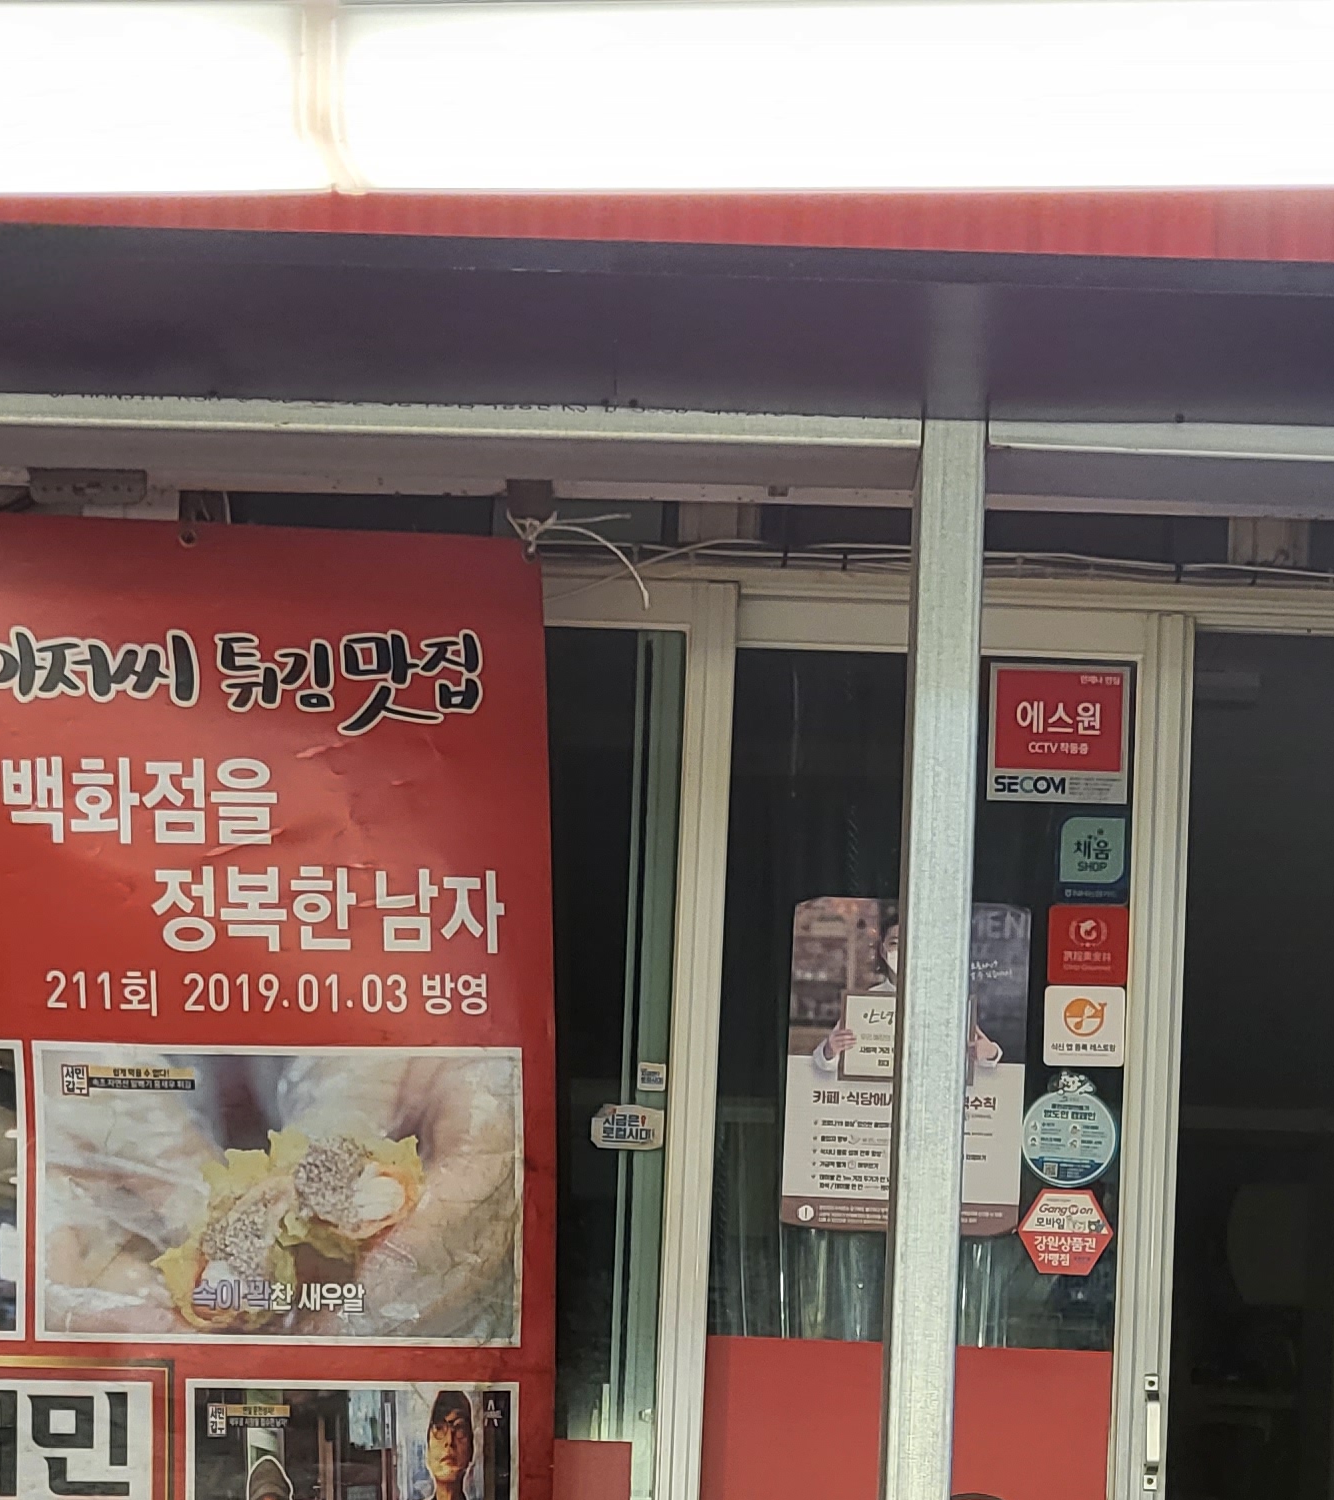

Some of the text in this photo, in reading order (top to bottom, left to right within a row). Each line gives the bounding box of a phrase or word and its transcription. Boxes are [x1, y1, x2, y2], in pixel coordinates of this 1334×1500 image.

[1016, 700, 1101, 735] 에스원
[1028, 742, 1058, 754] CCTV
[994, 776, 1065, 794] SECOM
[2, 756, 277, 844] 백화점을
[1073, 837, 1111, 860] 채움
[1077, 861, 1107, 872] SHOP
[152, 865, 505, 954] 정복한 남자
[46, 970, 488, 1016] 211회 2019.01.03 방영
[1035, 1217, 1065, 1229] 모바일
[1034, 1235, 1096, 1252] 강원상품권
[1038, 1252, 1069, 1266] 가맹점
[192, 1280, 241, 1311] 속이
[298, 1283, 366, 1312] 새우알
